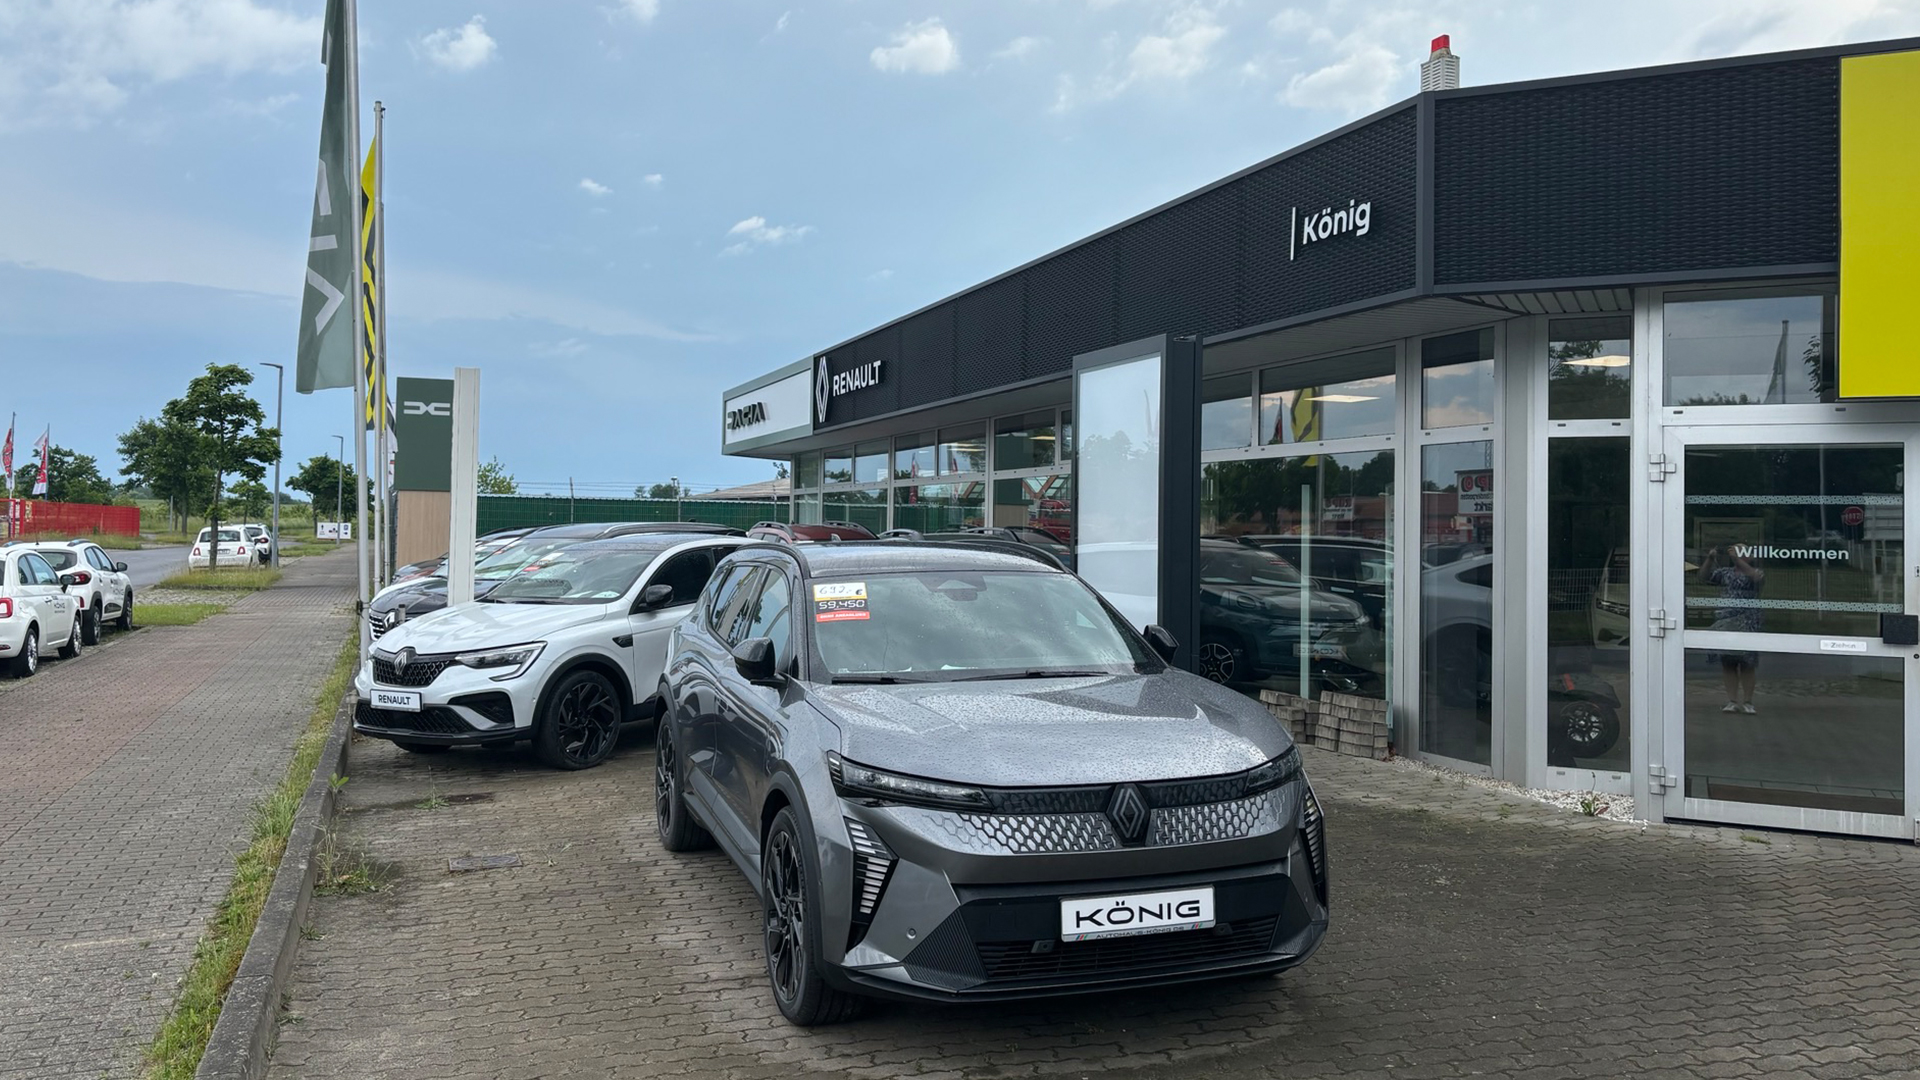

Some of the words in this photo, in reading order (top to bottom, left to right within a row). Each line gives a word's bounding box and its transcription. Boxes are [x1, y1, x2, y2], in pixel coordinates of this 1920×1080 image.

[1303, 199, 1371, 245] König
[833, 360, 881, 397] RENAULT
[727, 402, 766, 430] DACIA
[1735, 546, 1849, 559] Willkommen
[378, 694, 411, 705] RENAULT
[1076, 900, 1200, 928] KÖNIG
